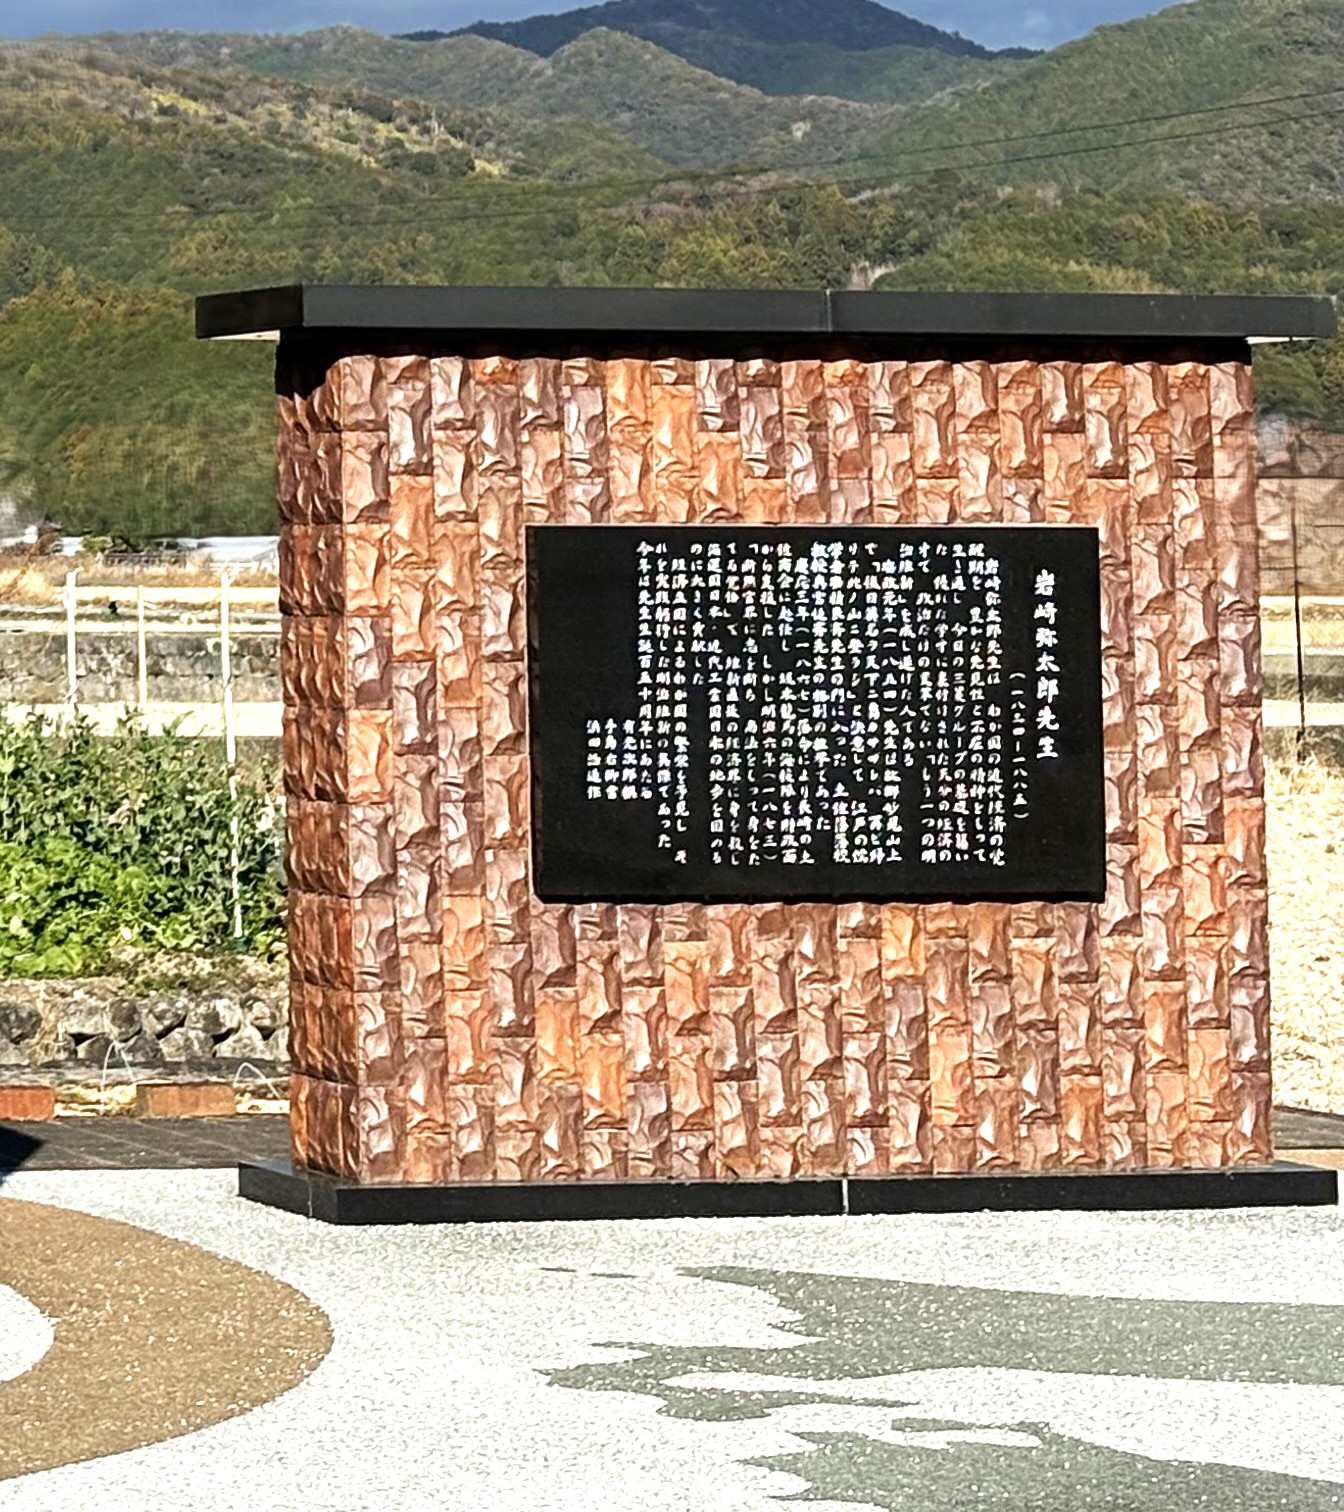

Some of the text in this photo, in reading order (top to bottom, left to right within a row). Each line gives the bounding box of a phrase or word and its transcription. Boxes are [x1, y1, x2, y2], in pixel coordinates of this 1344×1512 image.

[1035, 569, 1059, 758] 岩崎弥太郎先生
